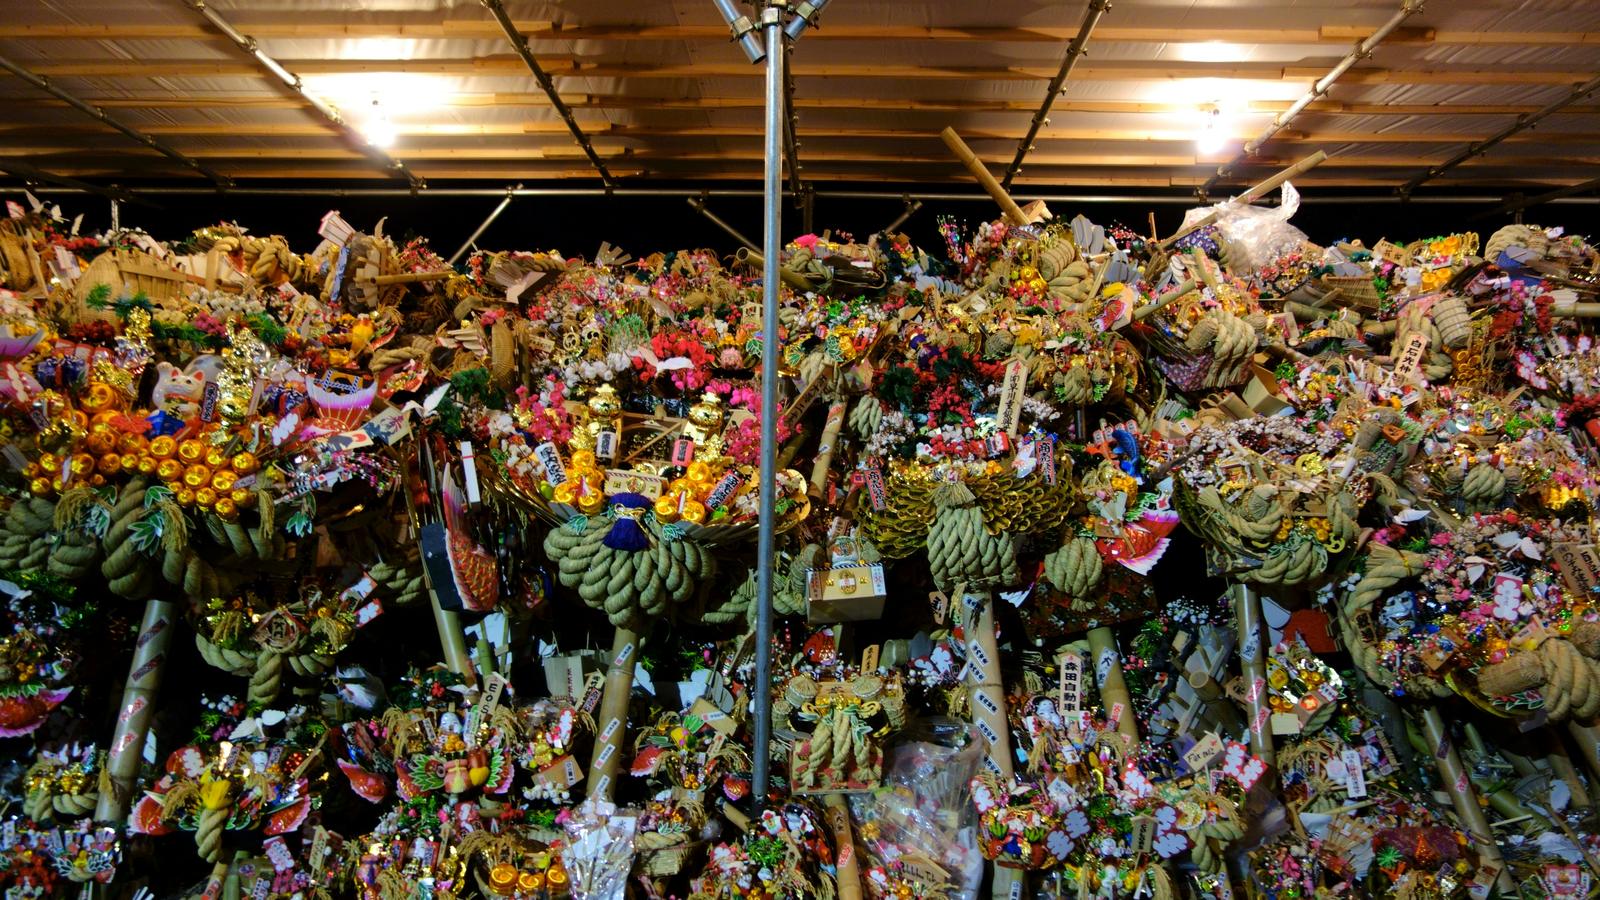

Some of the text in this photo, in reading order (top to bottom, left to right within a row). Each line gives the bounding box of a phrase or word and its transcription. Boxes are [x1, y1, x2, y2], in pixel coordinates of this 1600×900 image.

[481, 683, 498, 714] EOS
[1063, 661, 1078, 712] 森田自動車
